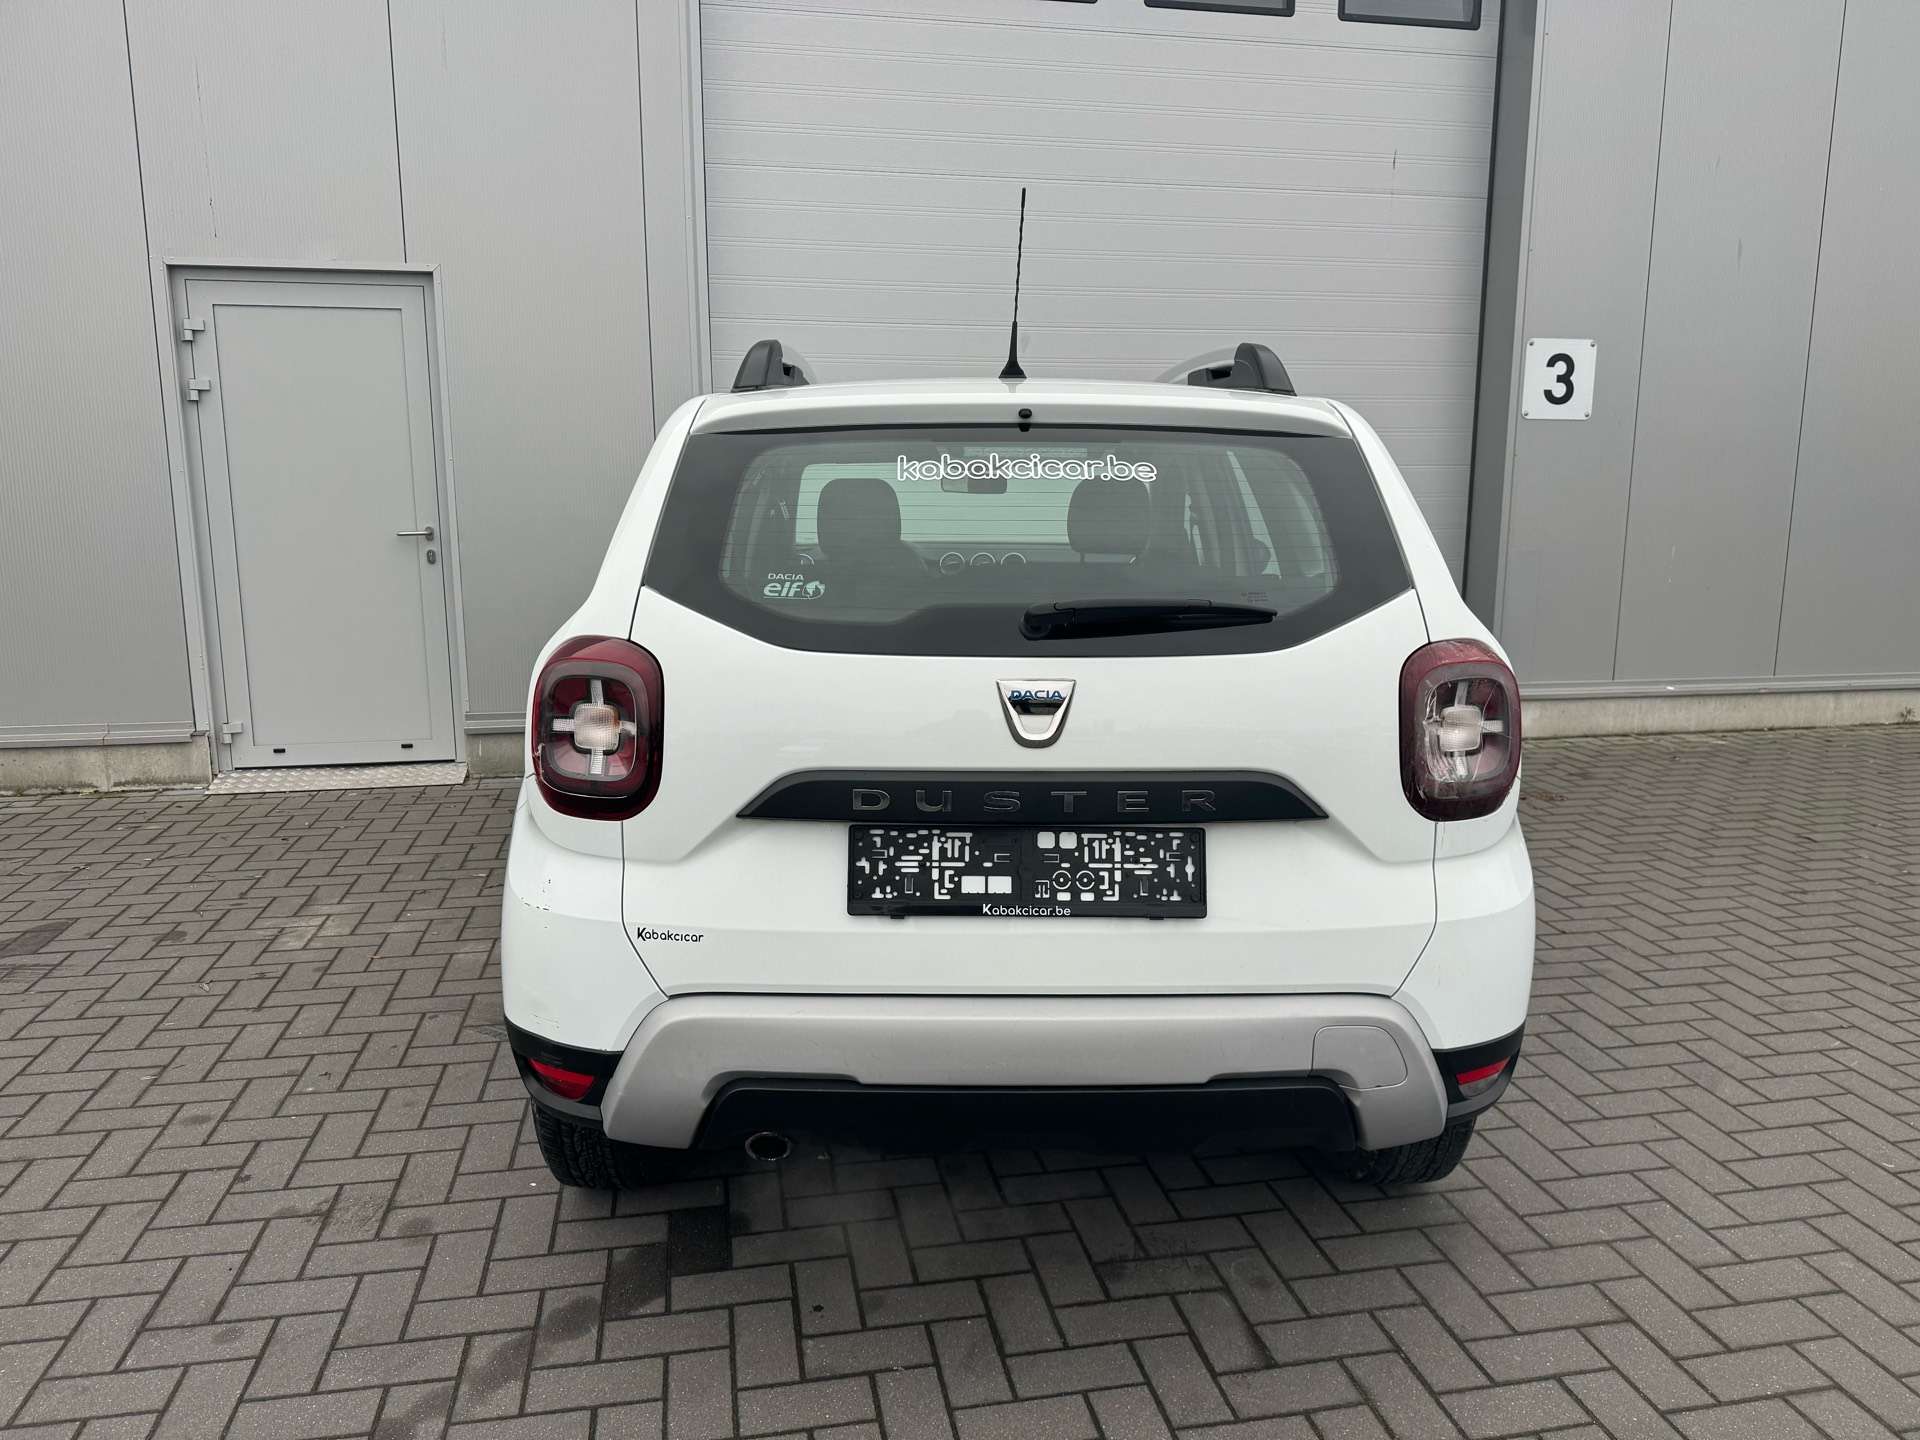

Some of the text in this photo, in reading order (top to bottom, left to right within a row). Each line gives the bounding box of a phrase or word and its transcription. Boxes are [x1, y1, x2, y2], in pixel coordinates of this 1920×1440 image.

[1543, 352, 1575, 406] 3
[897, 453, 1158, 482] kabakcicar.be
[763, 581, 804, 597] elf
[1009, 689, 1063, 700] DACIA
[852, 788, 1217, 813] DUSTER
[982, 903, 1071, 916] Kabakcicar.be
